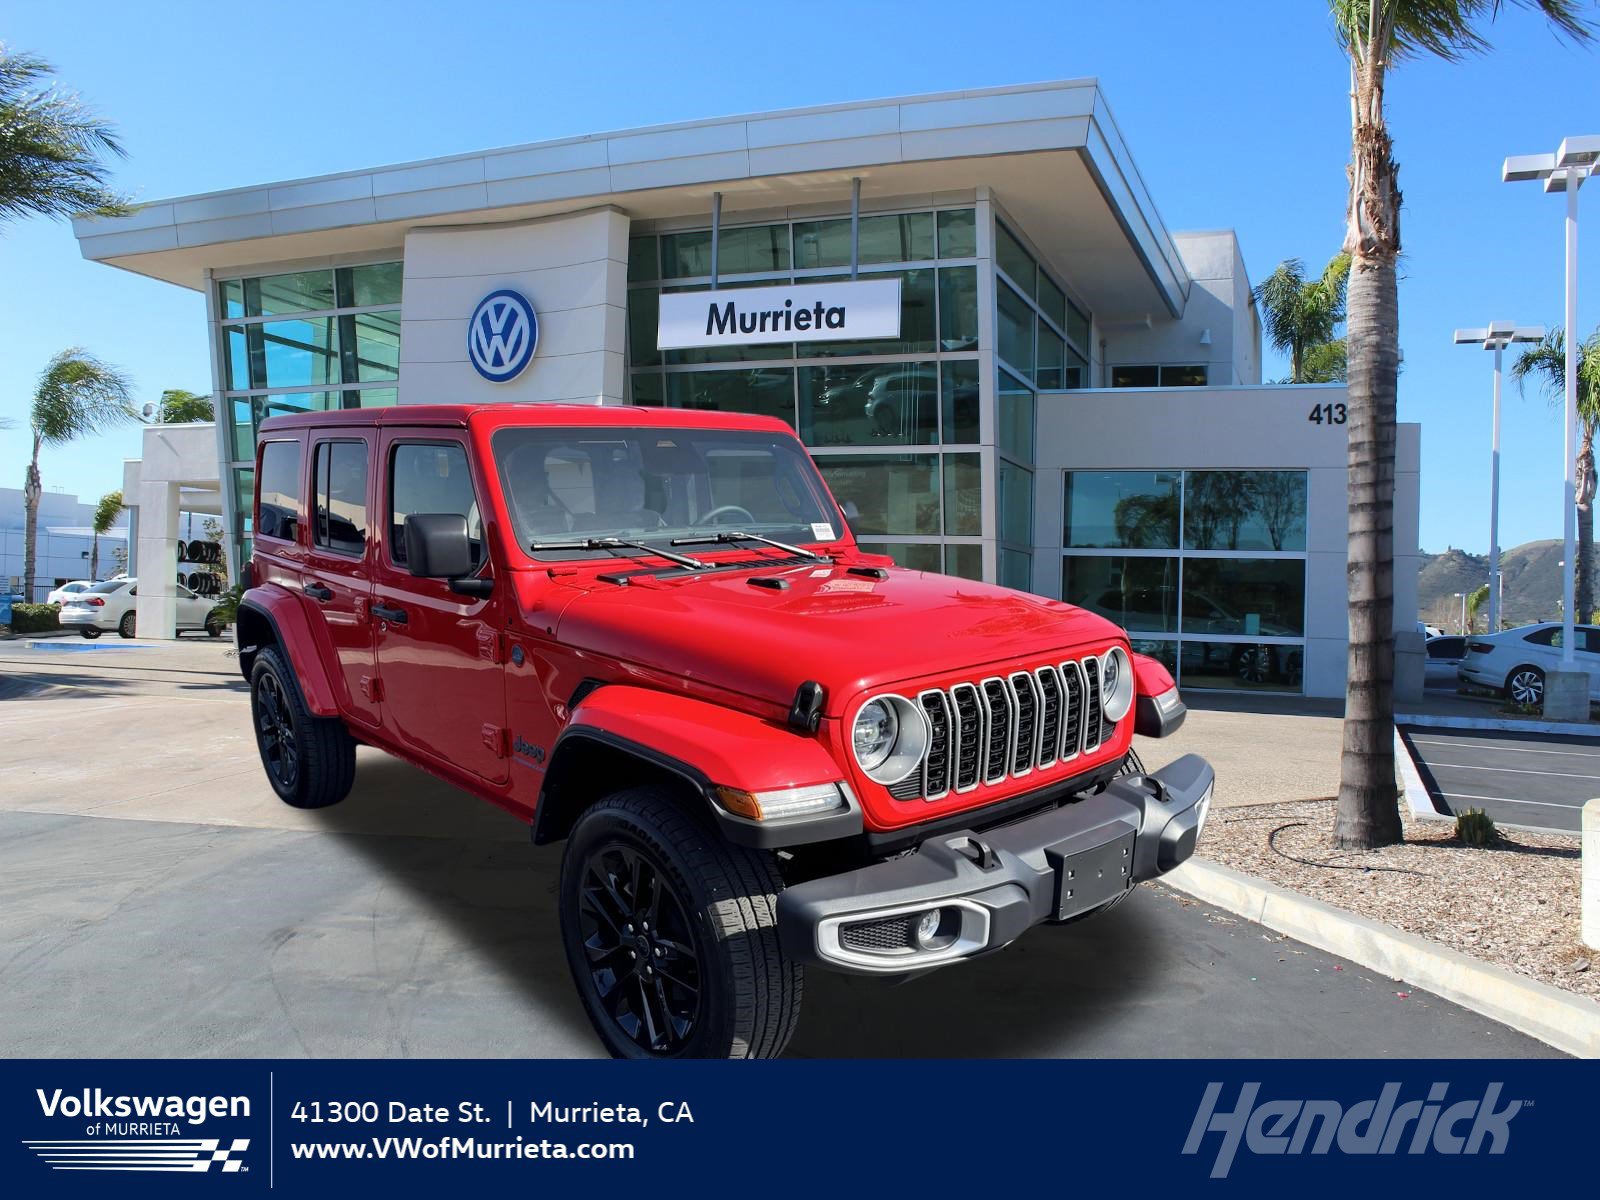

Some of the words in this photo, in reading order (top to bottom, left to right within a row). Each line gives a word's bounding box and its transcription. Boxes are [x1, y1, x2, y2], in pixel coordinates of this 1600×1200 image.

[472, 299, 531, 370] VW
[705, 299, 846, 336] Murrieta
[513, 735, 546, 765] Jeep
